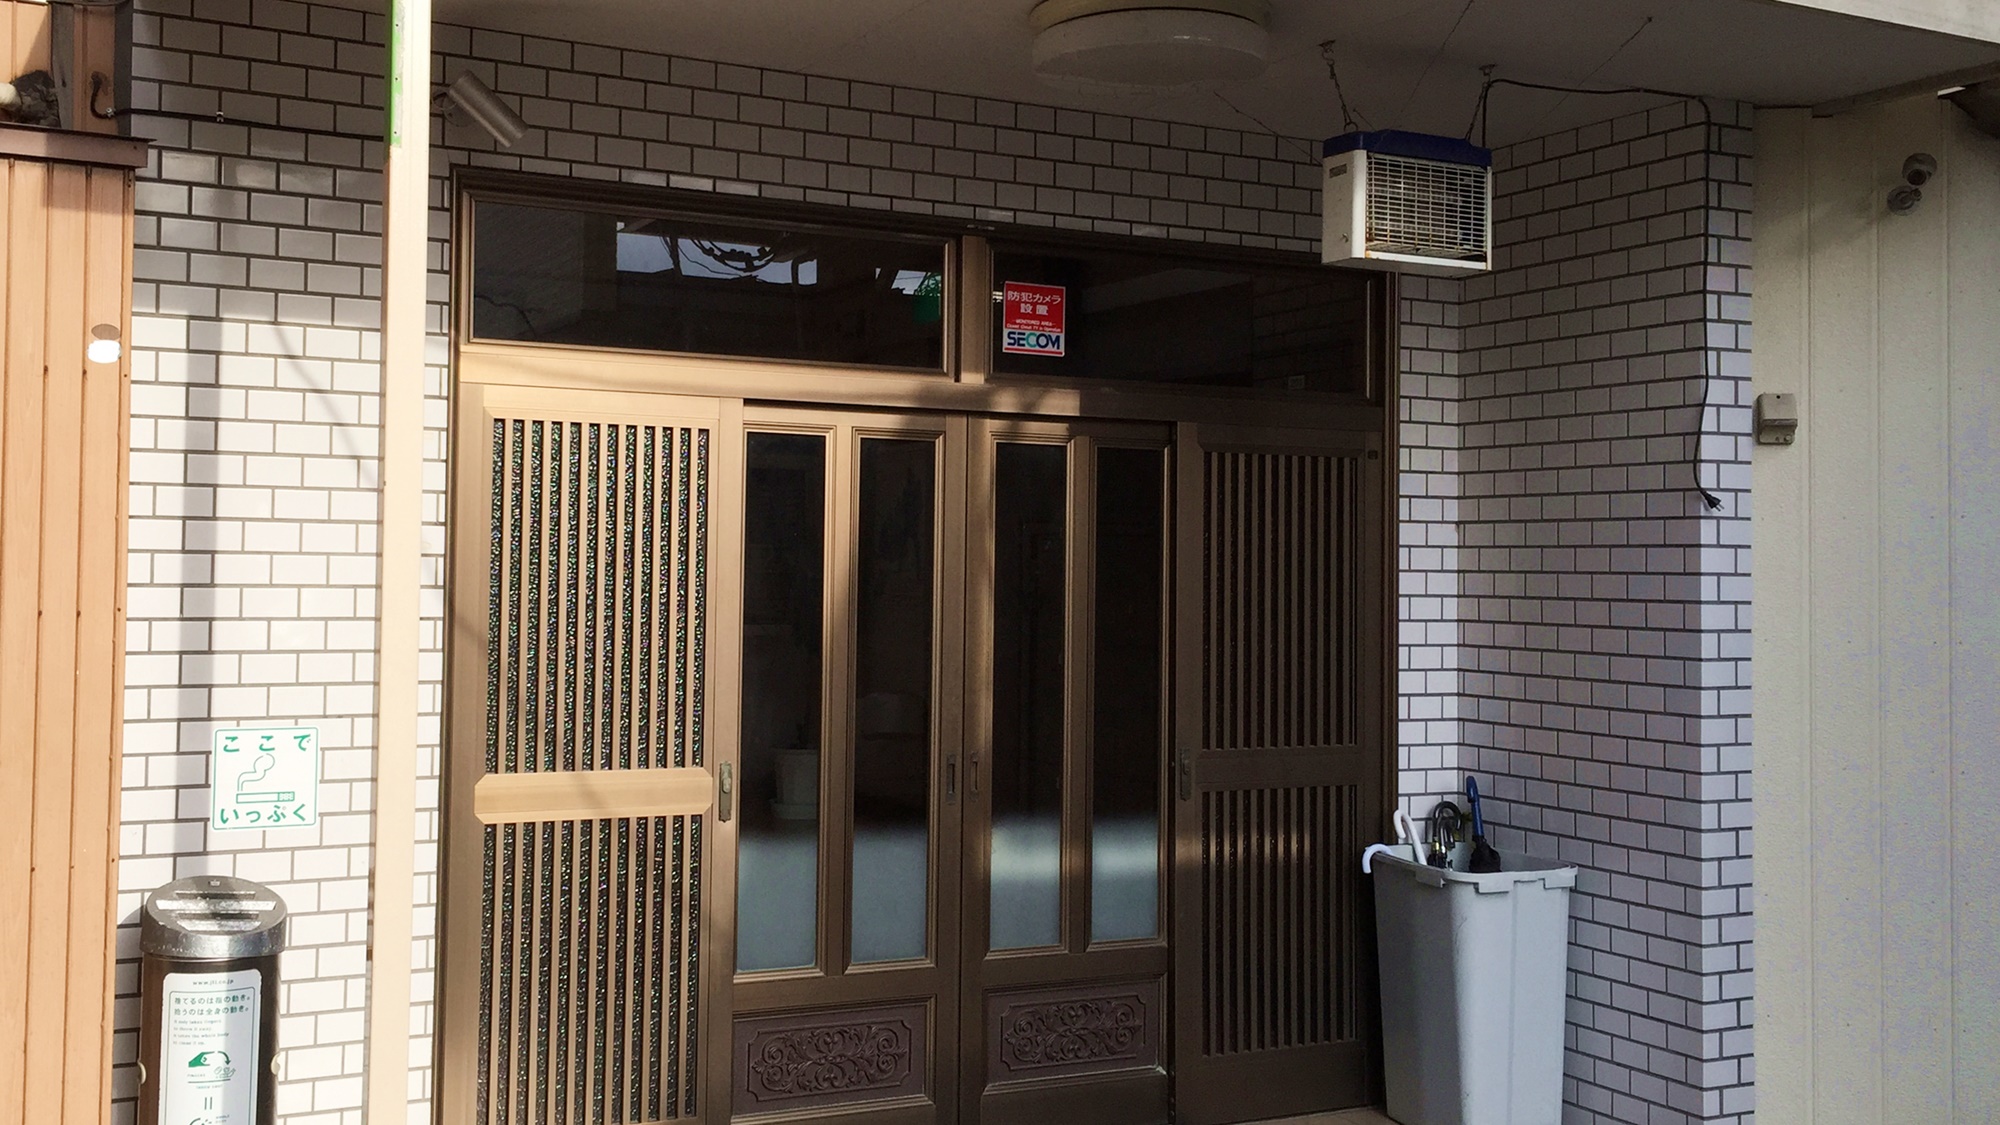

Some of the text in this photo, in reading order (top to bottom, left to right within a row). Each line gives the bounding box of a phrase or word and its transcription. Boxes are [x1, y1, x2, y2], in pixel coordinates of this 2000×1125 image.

[1007, 290, 1061, 305] 防犯カメラ
[1020, 303, 1048, 316] 設置
[1007, 331, 1060, 350] SECOM
[223, 734, 311, 752] ここで
[220, 803, 306, 824] いっぷく
